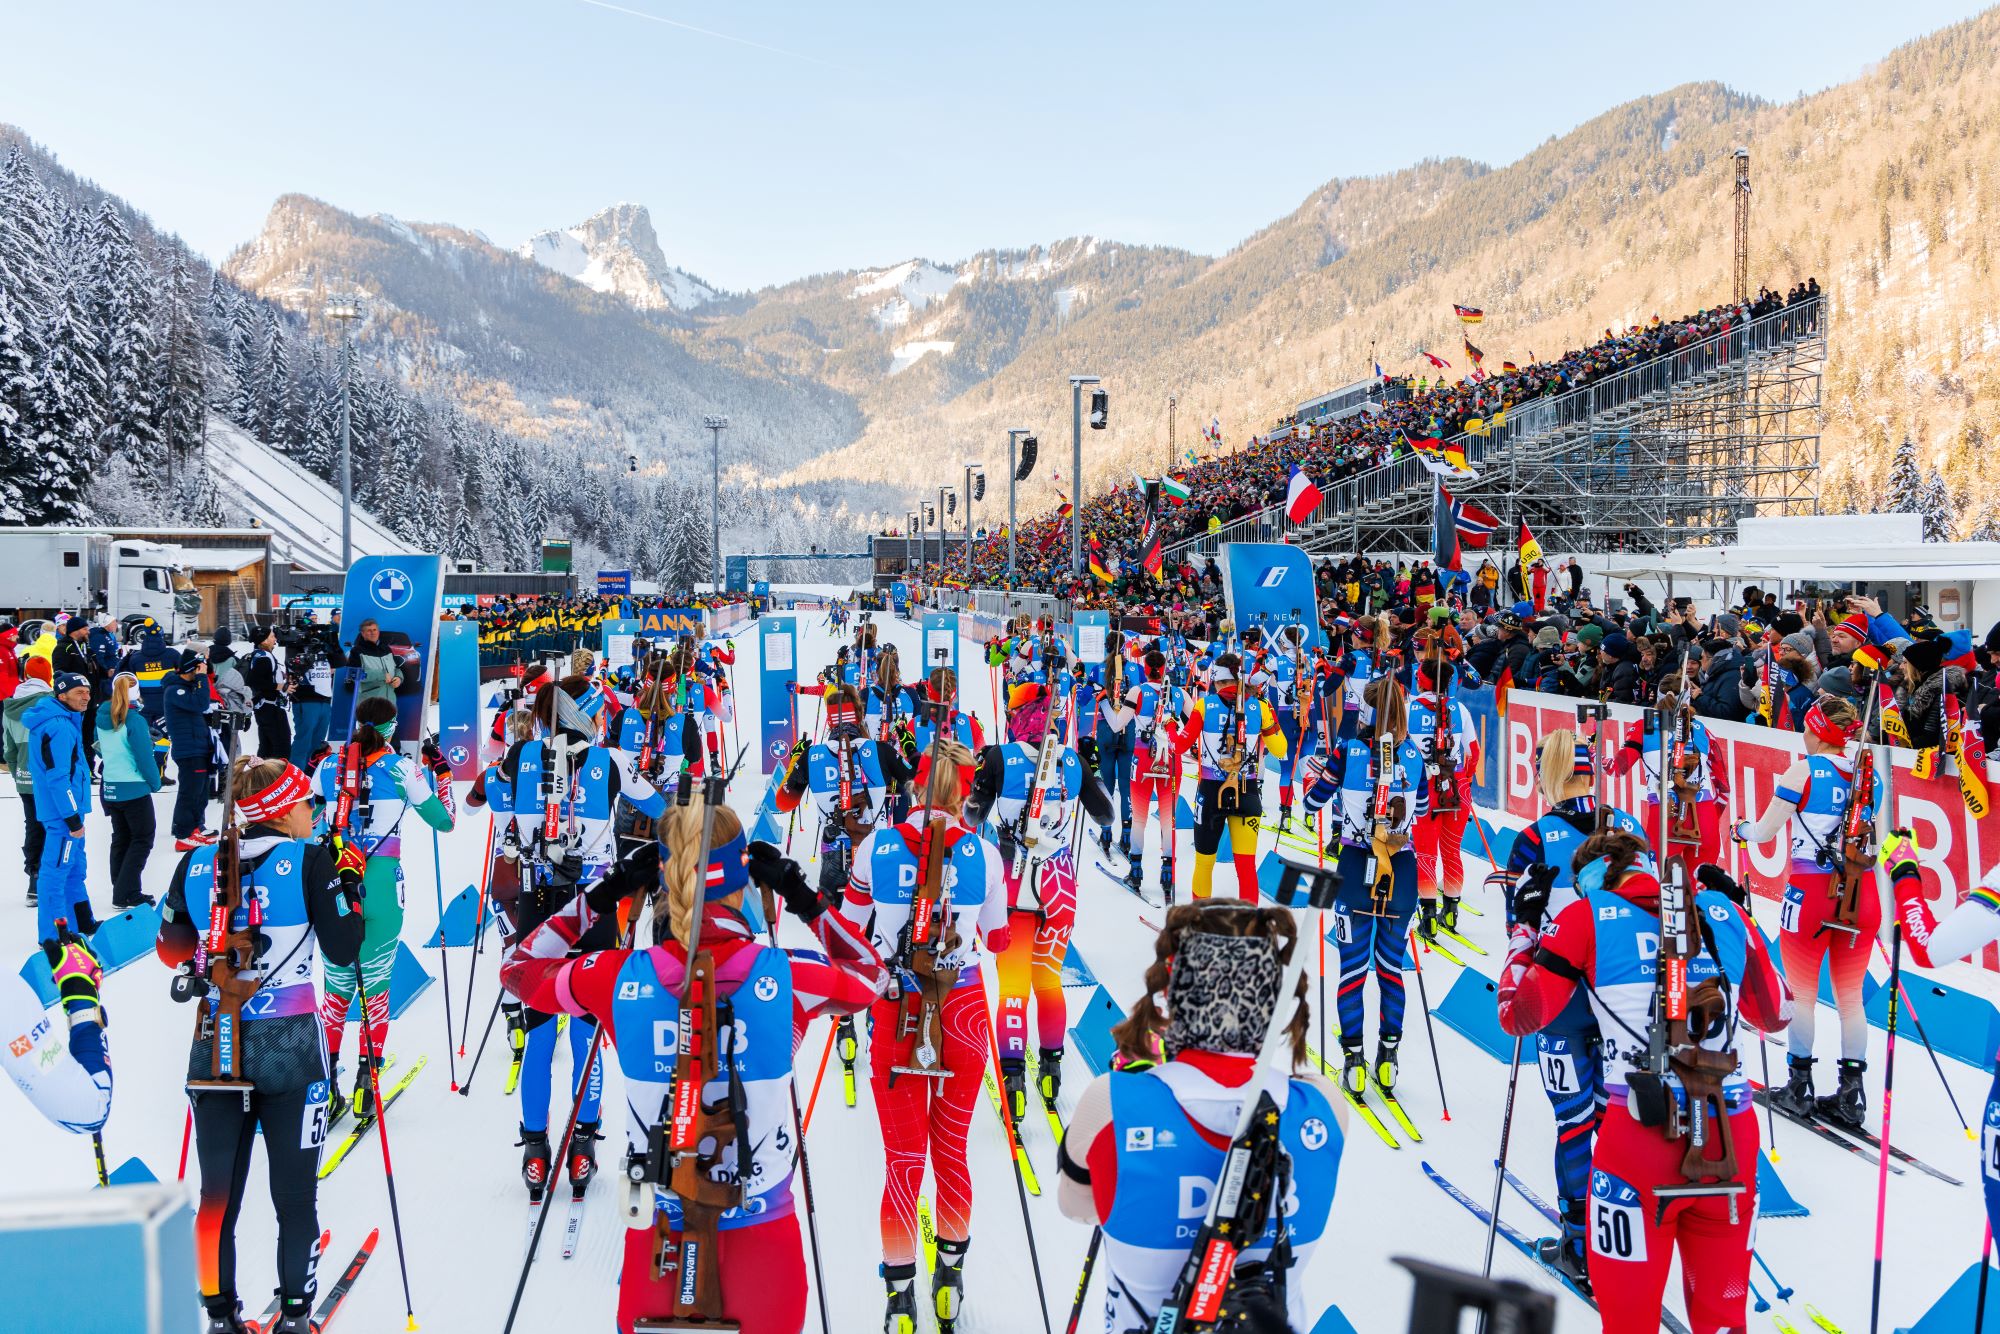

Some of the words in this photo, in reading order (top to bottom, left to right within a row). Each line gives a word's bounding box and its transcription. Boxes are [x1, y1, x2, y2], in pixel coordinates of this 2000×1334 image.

[314, 597, 336, 606] DKB
[444, 597, 466, 606] DKB
[455, 626, 462, 635] 5
[618, 625, 625, 633] 4
[772, 622, 780, 631] 3
[938, 618, 944, 627] 2
[1089, 615, 1094, 624] 1
[1384, 743, 1393, 773] somfy
[556, 775, 564, 794] LHV
[899, 864, 959, 887] DB
[1524, 890, 1542, 900] swix
[1663, 884, 1676, 936] HELLA
[212, 907, 223, 950] VIESSMANN
[915, 898, 926, 941] VIESSMANN
[69, 946, 87, 970] LEKI
[1641, 966, 1656, 976] Da
[1693, 964, 1719, 975] Bank
[1670, 960, 1682, 1018] VIESSMANN
[653, 1018, 748, 1056] DB
[681, 1010, 692, 1054] HELLA
[1006, 997, 1024, 1050] MDA
[402, 1066, 419, 1085] FISCHER
[586, 1037, 600, 1102] ETONIA
[655, 1061, 672, 1073] Da
[1546, 1053, 1571, 1093] 42
[676, 1082, 692, 1146] VIESSMANN
[1694, 1100, 1703, 1138] Husqvarna
[1226, 1178, 1242, 1206] garage
[1234, 1150, 1248, 1174] mark
[1178, 1175, 1300, 1220] DB
[924, 1212, 938, 1246] FISCHER
[1176, 1226, 1198, 1238] Da
[1598, 1204, 1634, 1258] 50
[683, 1243, 697, 1295] Husqvarna
[1194, 1242, 1226, 1318] VIESSMANN
